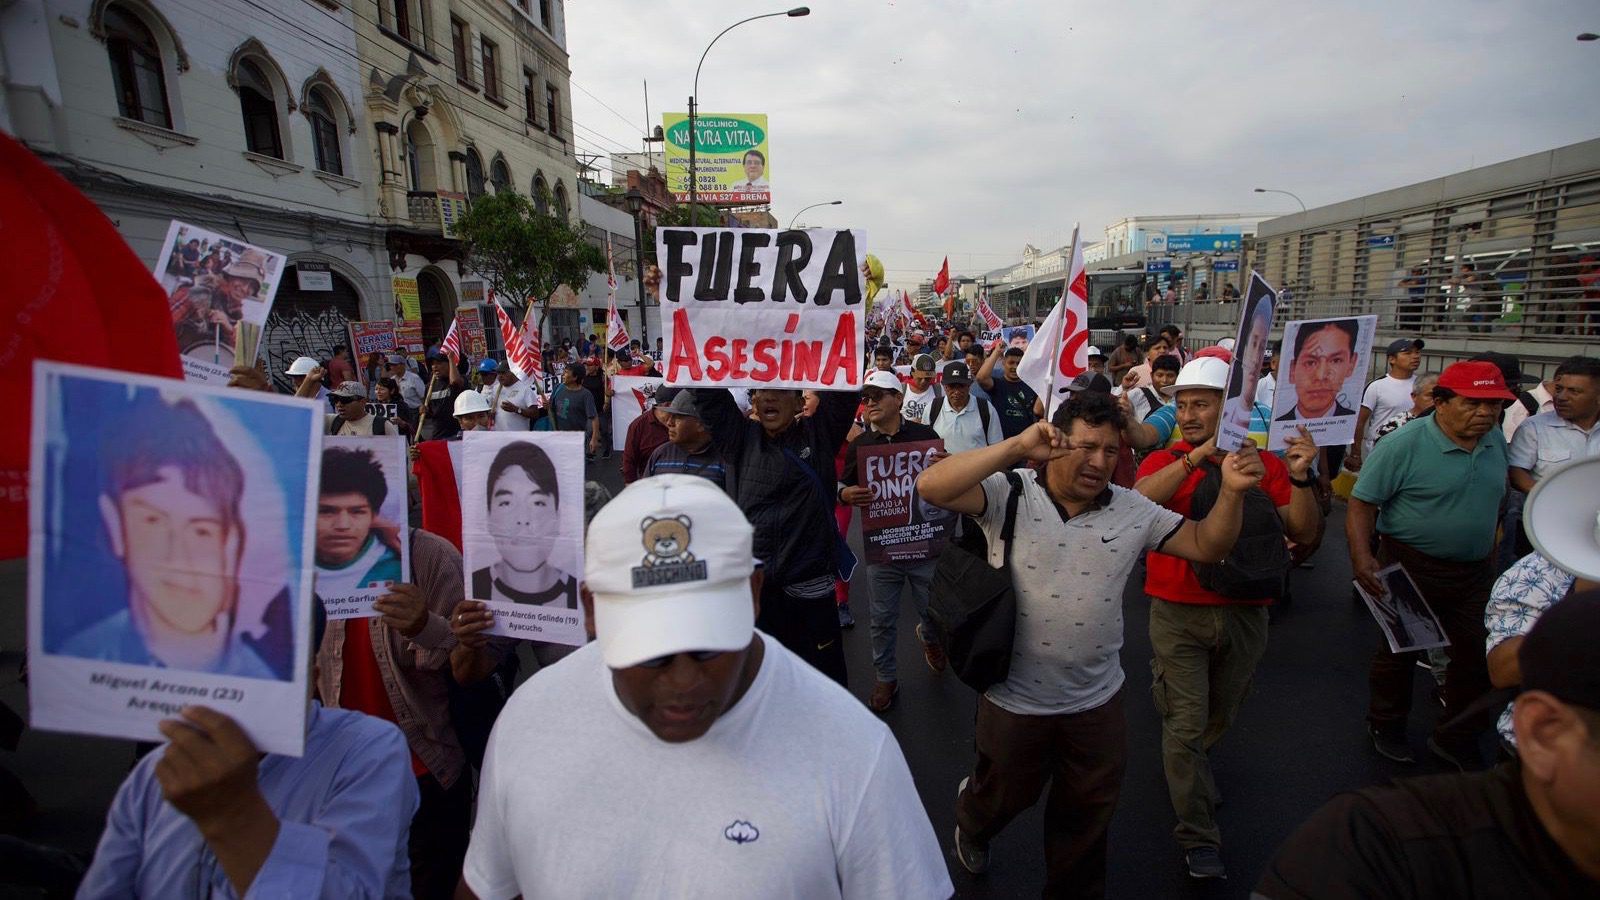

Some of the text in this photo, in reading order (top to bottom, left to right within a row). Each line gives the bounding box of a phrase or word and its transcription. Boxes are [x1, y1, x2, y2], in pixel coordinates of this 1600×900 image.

[674, 130, 758, 146] NAURA VITAL
[662, 228, 863, 306] FUERA
[356, 331, 393, 345] VERANO
[359, 341, 393, 354] REPASO
[894, 498, 903, 507] LA
[920, 525, 944, 535] NUEVA
[633, 561, 706, 587] MOSCHINO
[322, 595, 346, 606] uispe
[327, 607, 360, 616] urimac
[510, 610, 536, 621] Alarcón
[537, 613, 564, 624] Galindo
[565, 616, 579, 627] (19)
[509, 621, 543, 633] Ayacucho
[89, 672, 147, 690] Miguel
[212, 687, 245, 703] (23)
[127, 696, 186, 715] Arequ
